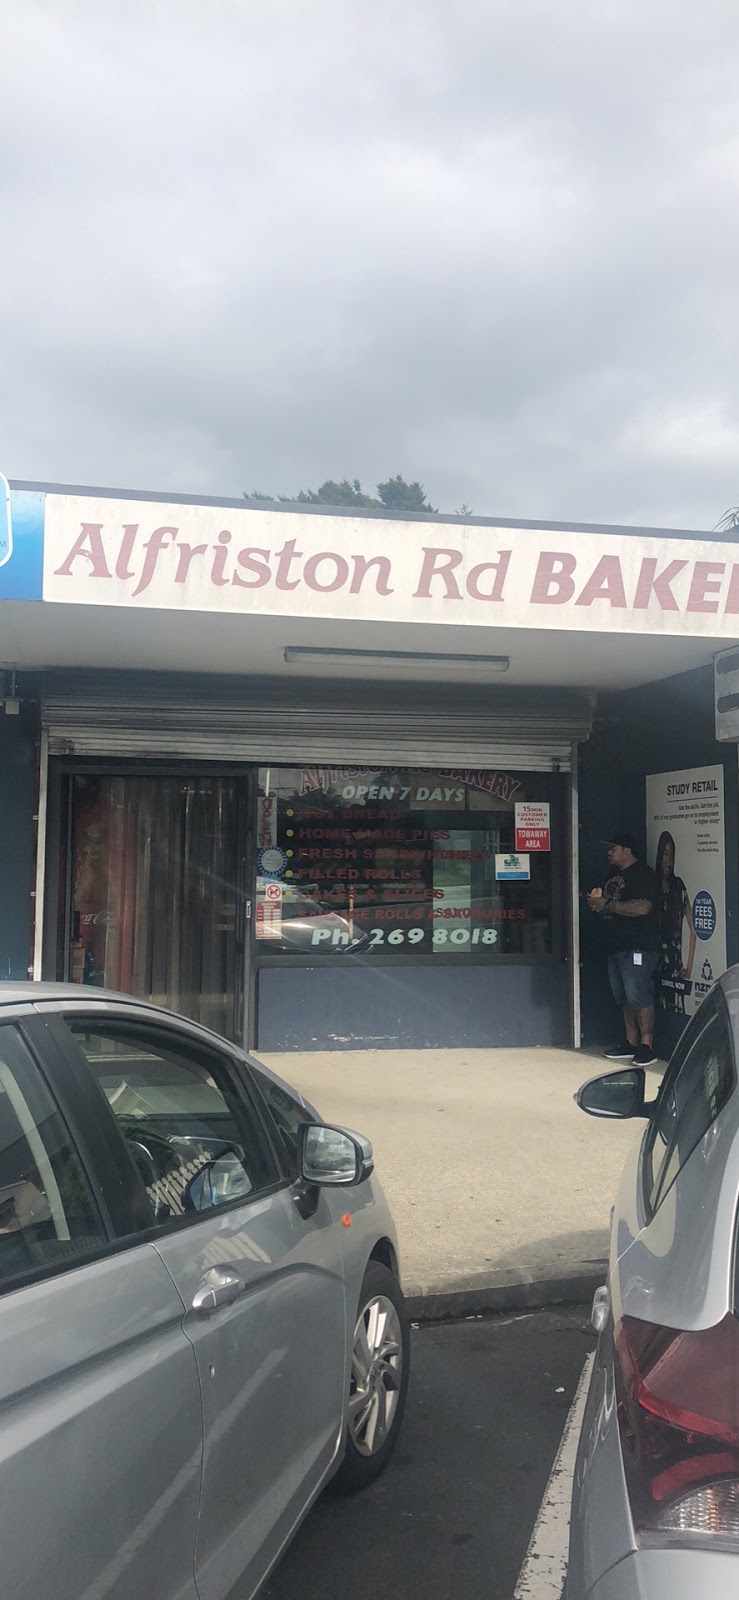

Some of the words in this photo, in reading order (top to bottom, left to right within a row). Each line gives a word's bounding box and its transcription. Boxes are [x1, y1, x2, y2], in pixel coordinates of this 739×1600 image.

[54, 523, 394, 597] Alfriston
[412, 547, 512, 602] Rd
[342, 785, 395, 800] OPEN
[399, 787, 411, 800] 7
[416, 787, 465, 801] DAYS
[667, 783, 690, 796] STUDY
[692, 780, 718, 793] RETAIL
[341, 808, 400, 820] BREAD
[299, 828, 351, 839] HOME
[357, 829, 405, 840] MADE
[413, 829, 451, 840] PIES
[518, 830, 548, 838] TOWAWAY
[525, 840, 541, 848] AREA
[298, 848, 357, 859] FRESH
[298, 868, 359, 880] FILLED
[365, 869, 422, 880] ROLLS
[365, 888, 377, 899] &
[297, 909, 369, 920] SAAGE
[375, 909, 422, 920] ROLLS
[695, 905, 712, 917] FEES
[311, 929, 360, 946] Ph.
[368, 928, 424, 945] 269
[432, 928, 498, 945] 8018
[675, 982, 685, 991] NOW
